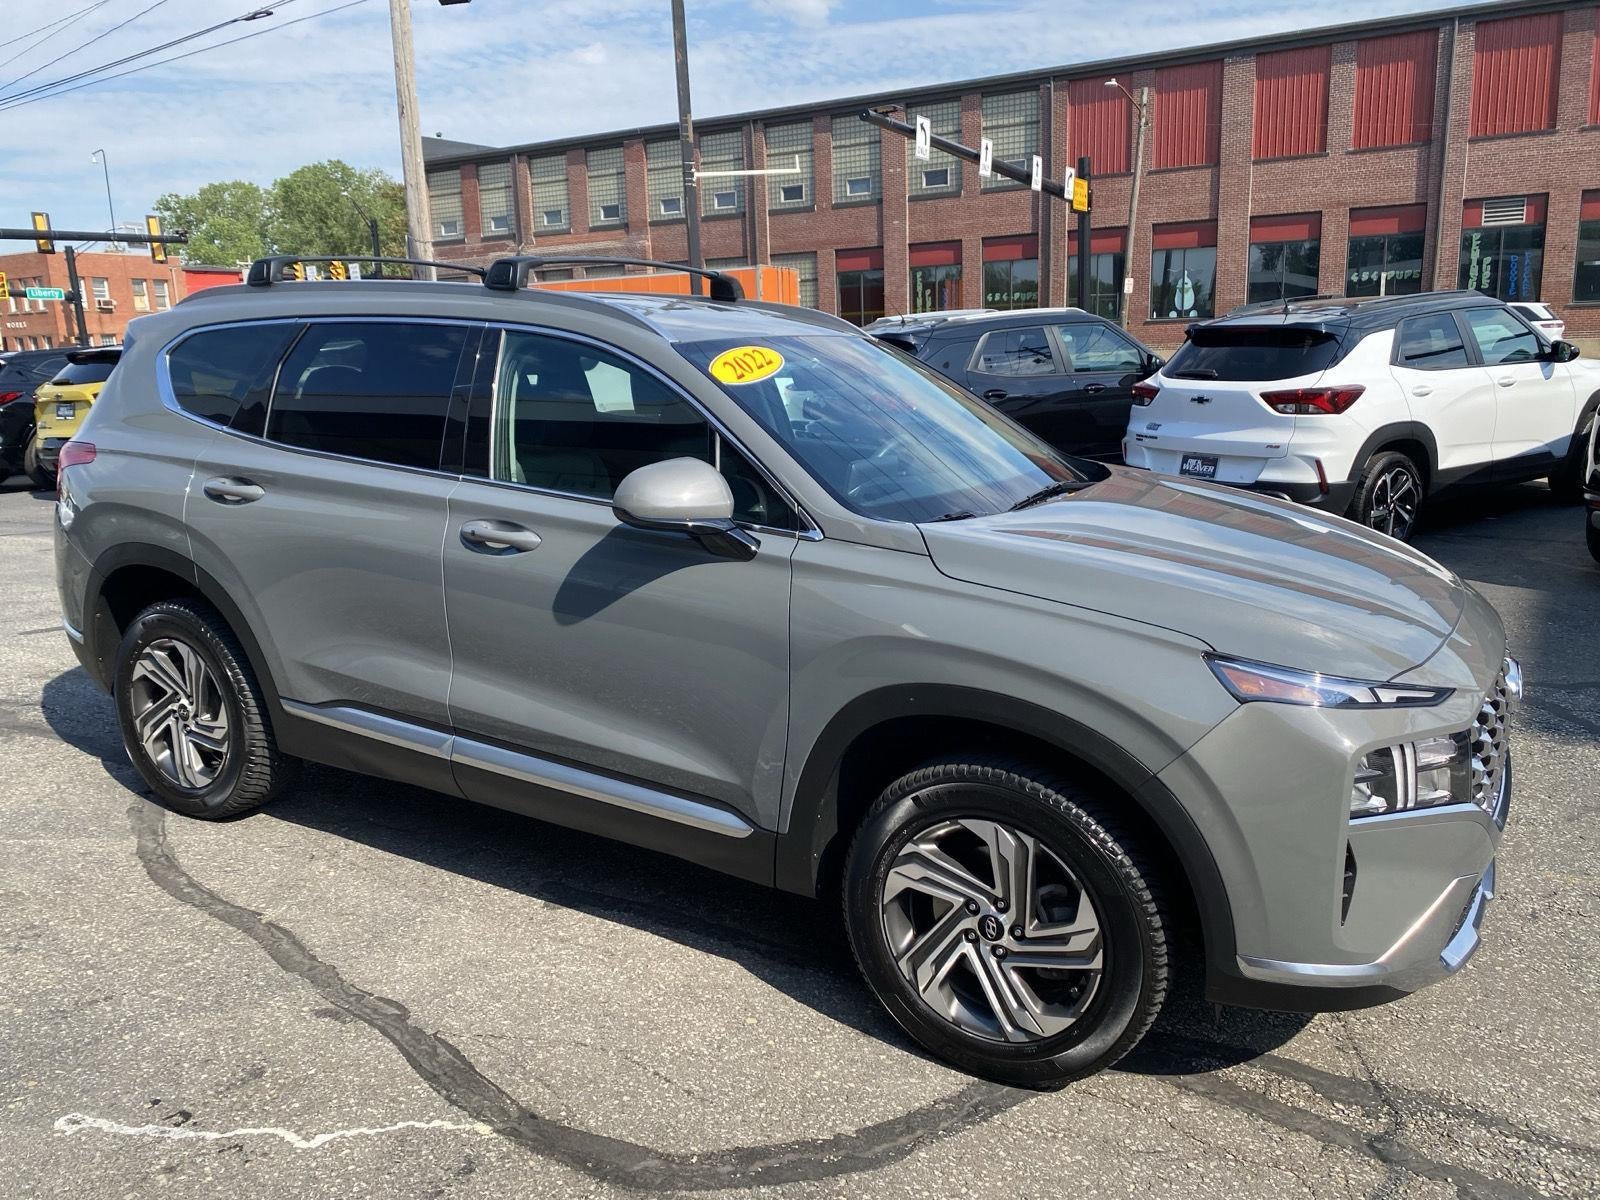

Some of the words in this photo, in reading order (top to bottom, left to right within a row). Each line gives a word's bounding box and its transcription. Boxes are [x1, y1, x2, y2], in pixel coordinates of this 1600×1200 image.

[30, 288, 60, 299] Liberty
[722, 349, 774, 380] 2022
[1182, 463, 1215, 473] WEAVER
